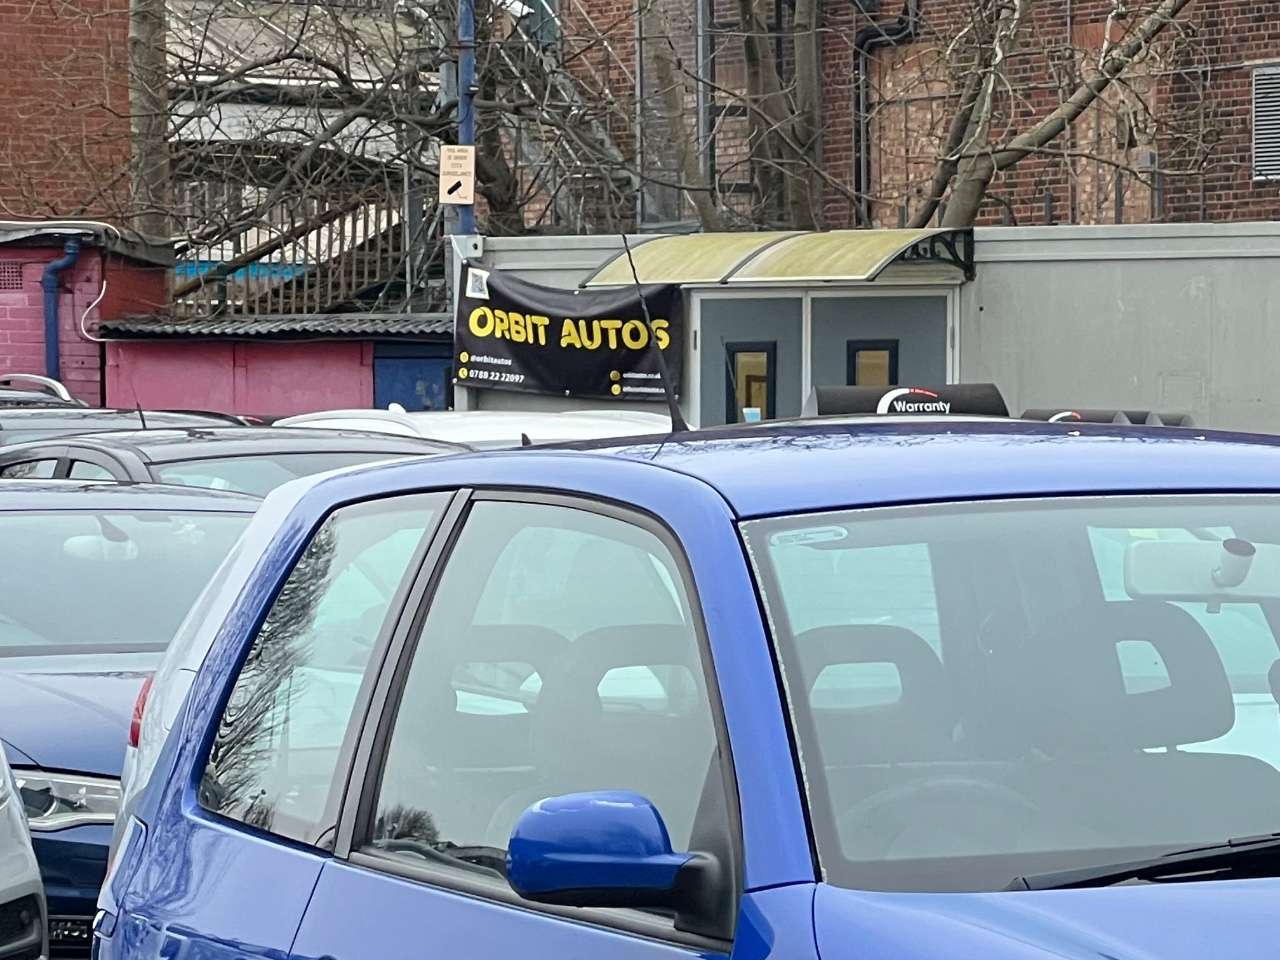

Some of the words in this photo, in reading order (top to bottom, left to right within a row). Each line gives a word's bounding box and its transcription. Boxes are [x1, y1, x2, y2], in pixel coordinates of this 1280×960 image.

[469, 306, 549, 346] ORBIT
[560, 318, 670, 350] AUTOS
[893, 400, 950, 415] Warranty
